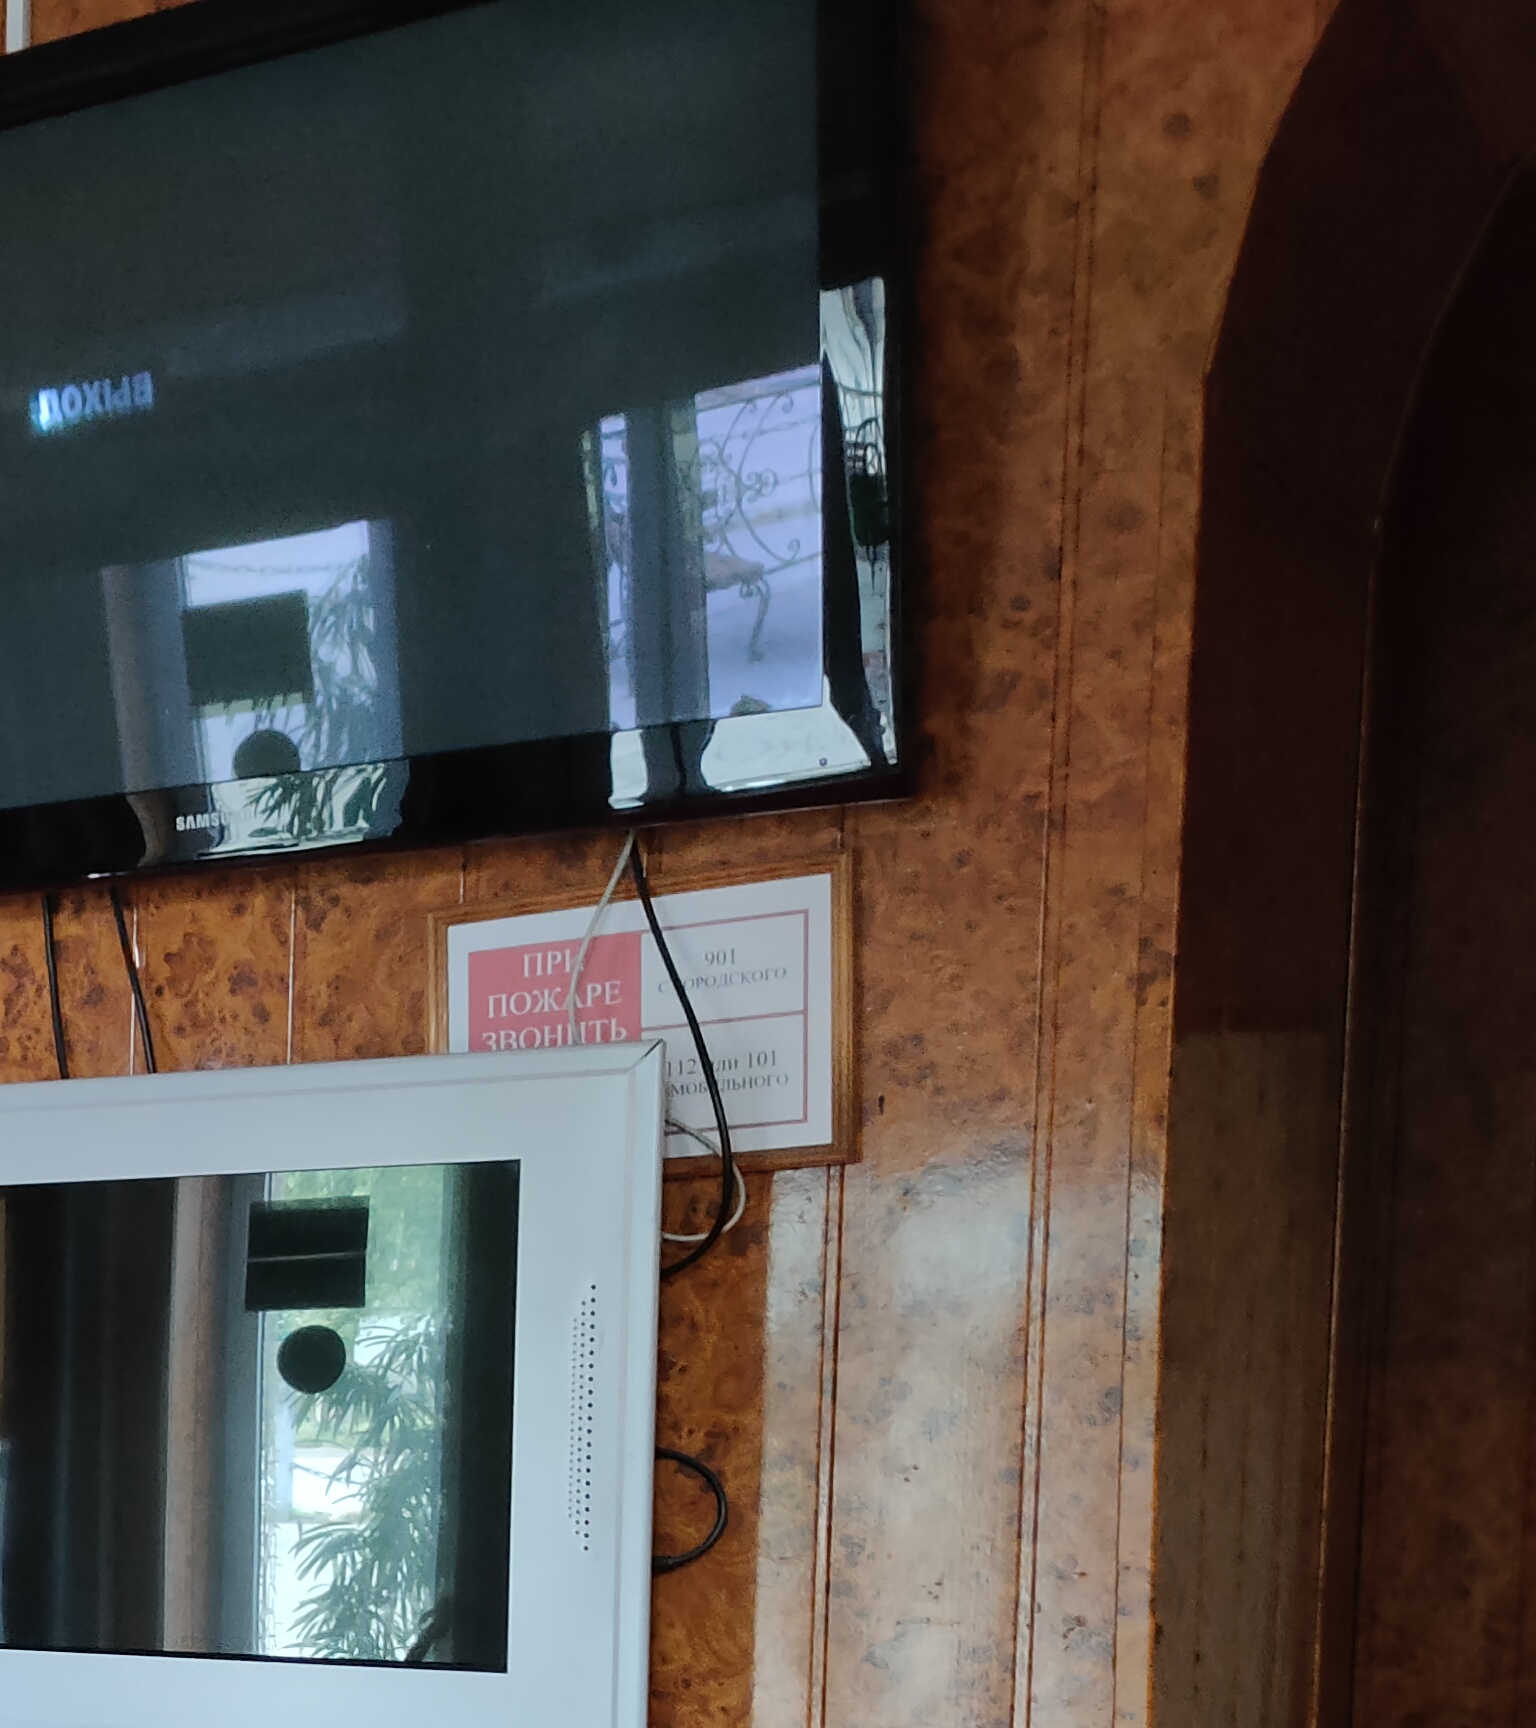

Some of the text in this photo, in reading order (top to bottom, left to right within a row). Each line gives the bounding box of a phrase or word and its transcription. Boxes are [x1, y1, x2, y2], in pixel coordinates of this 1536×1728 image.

[704, 948, 736, 966] 901
[678, 967, 788, 990] ОРОДСКОГО
[747, 1050, 777, 1069] 101
[670, 1073, 789, 1097] МОБЛЬНОГО
